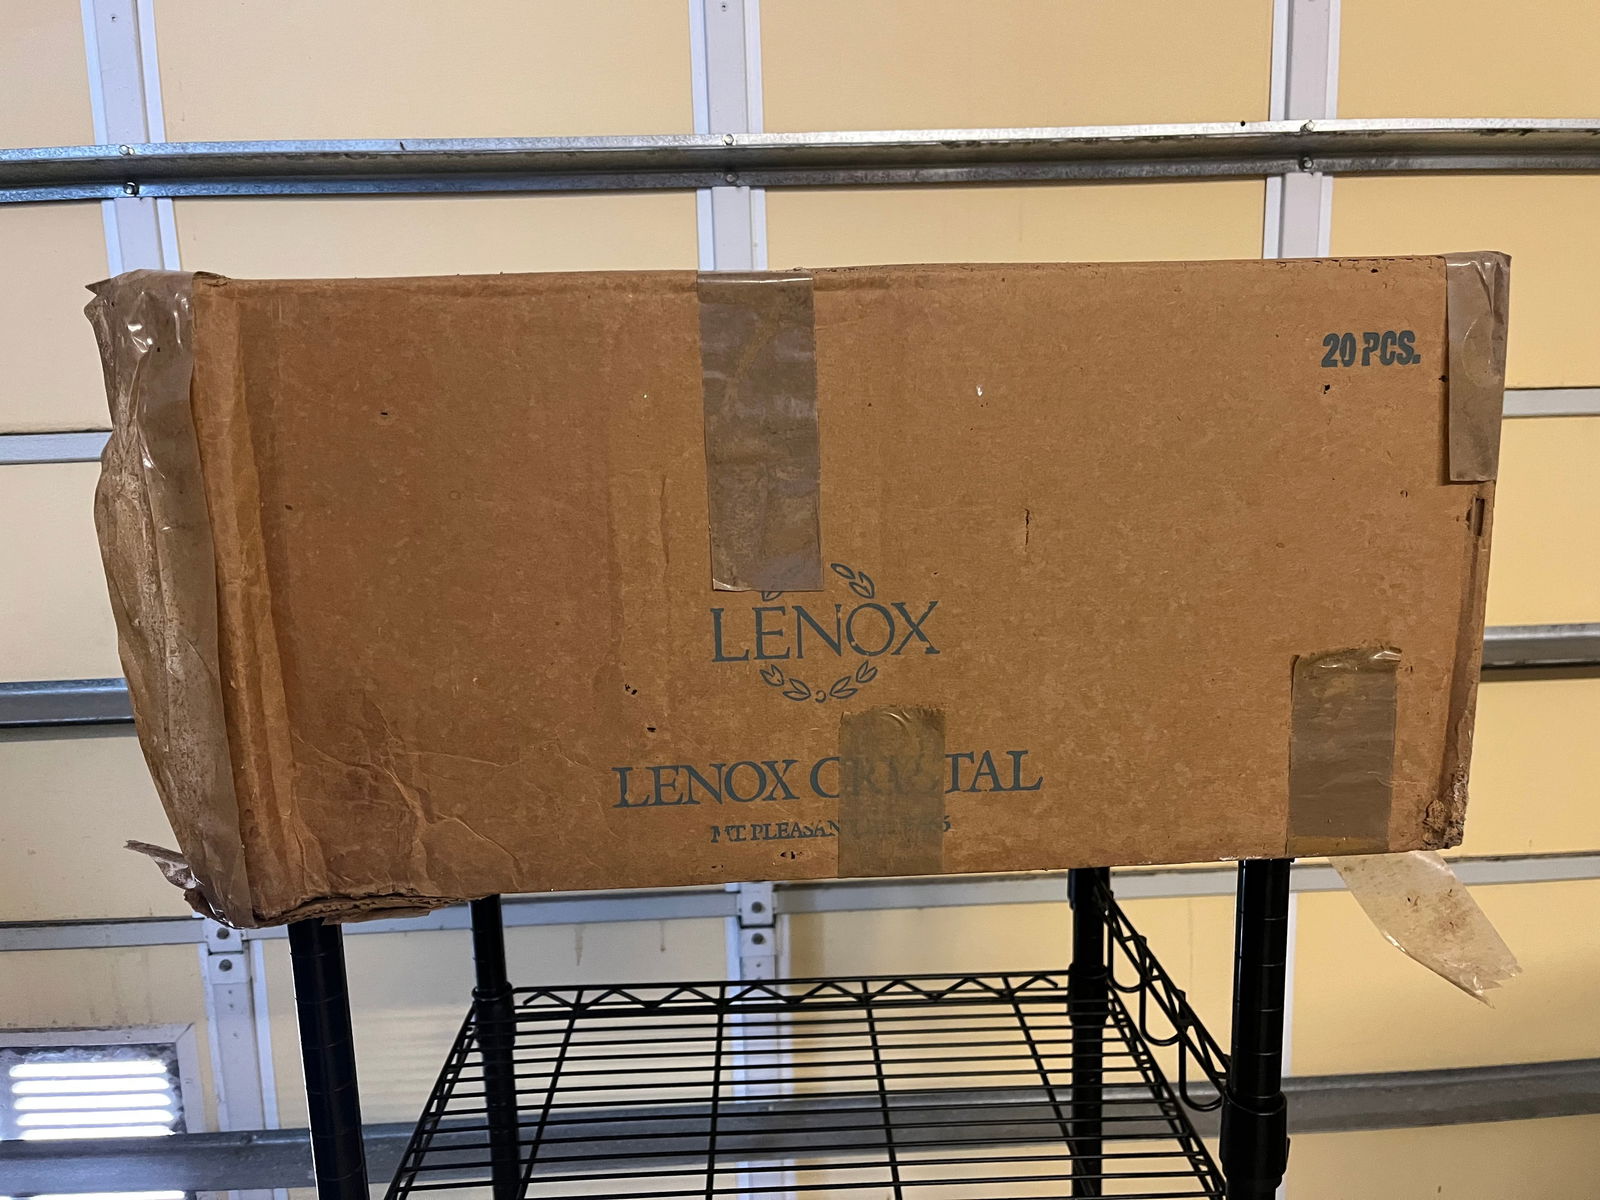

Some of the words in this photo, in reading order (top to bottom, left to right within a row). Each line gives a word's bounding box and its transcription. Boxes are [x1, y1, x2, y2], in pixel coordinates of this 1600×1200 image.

[1321, 332, 1357, 368] 20
[1361, 330, 1421, 366] PCS.
[710, 601, 941, 663] LENOX
[611, 759, 800, 809] LENOX
